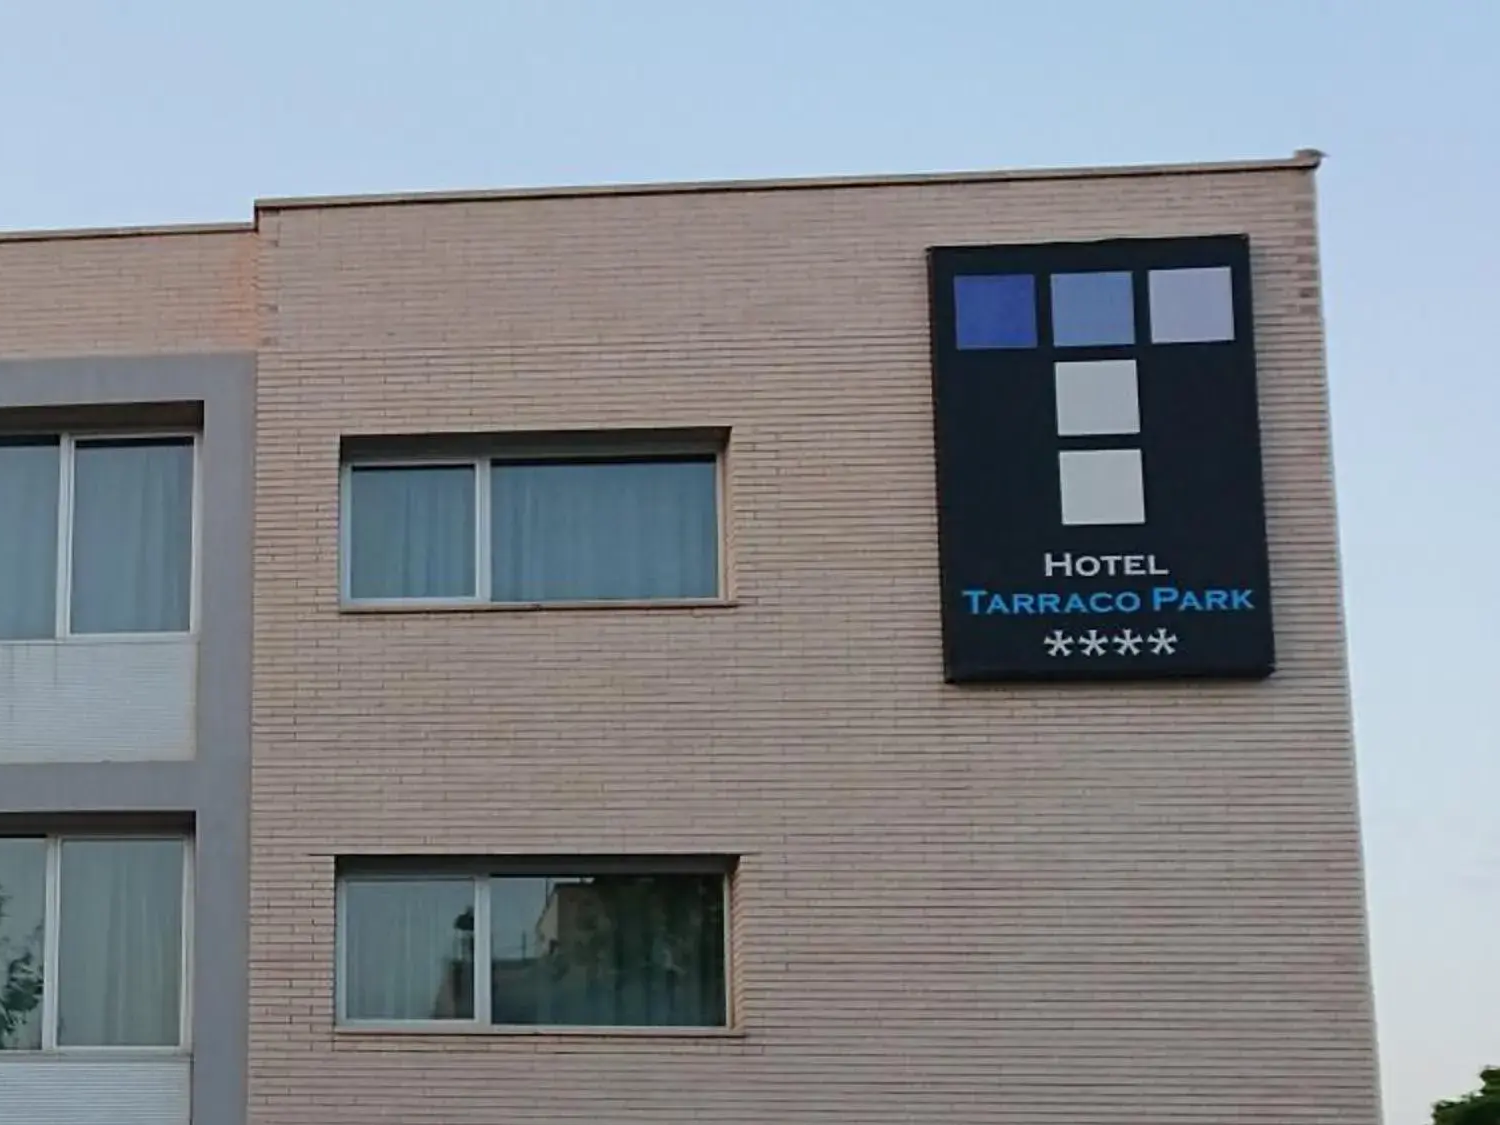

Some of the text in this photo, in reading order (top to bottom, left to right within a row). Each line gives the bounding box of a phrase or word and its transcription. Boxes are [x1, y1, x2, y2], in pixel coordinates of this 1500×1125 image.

[1044, 552, 1169, 577] HOTEL
[962, 586, 1255, 615] TARRACO PARK
